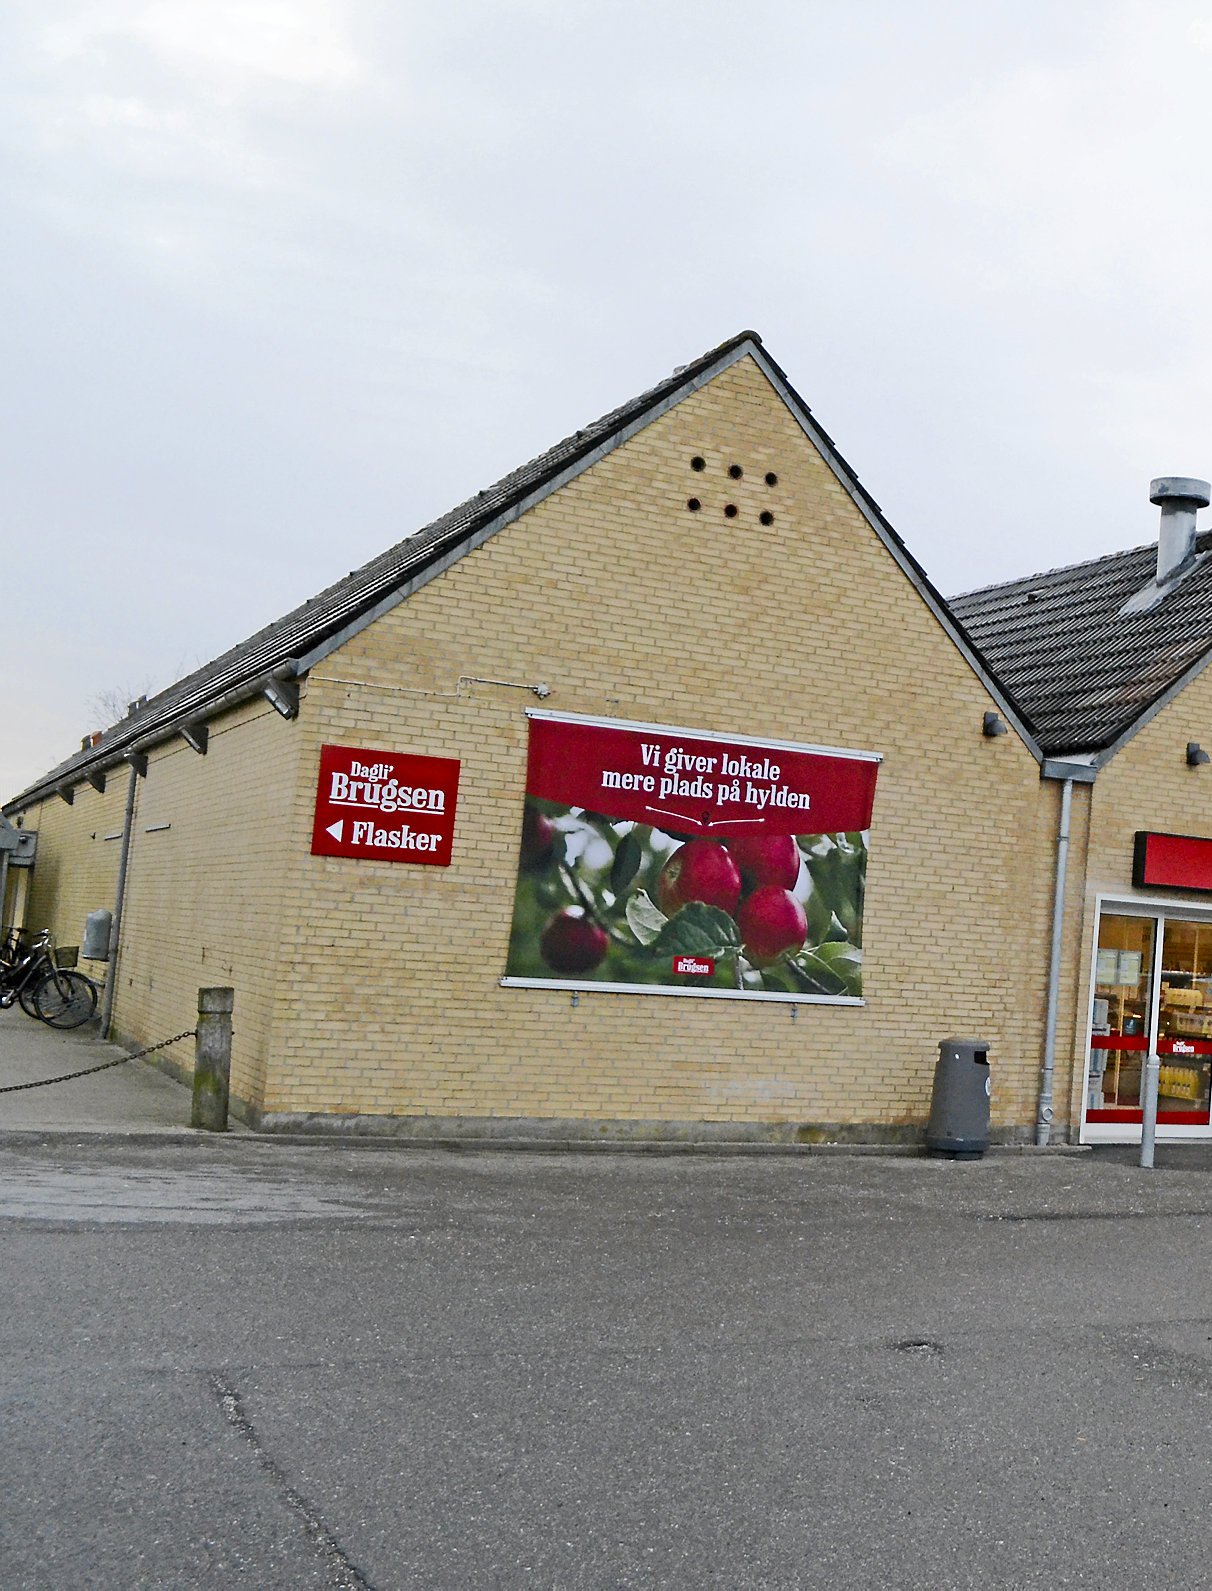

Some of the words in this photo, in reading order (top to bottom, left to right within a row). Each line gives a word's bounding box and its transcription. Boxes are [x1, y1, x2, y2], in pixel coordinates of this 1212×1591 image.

[641, 743, 660, 767] Vi
[664, 748, 717, 774] giver
[721, 753, 780, 780] lokale
[329, 772, 445, 812] Brugsen
[601, 770, 655, 792] mere
[659, 773, 713, 799] plads
[716, 779, 741, 806] på
[745, 781, 811, 810] hylden
[351, 821, 442, 852] Flasker
